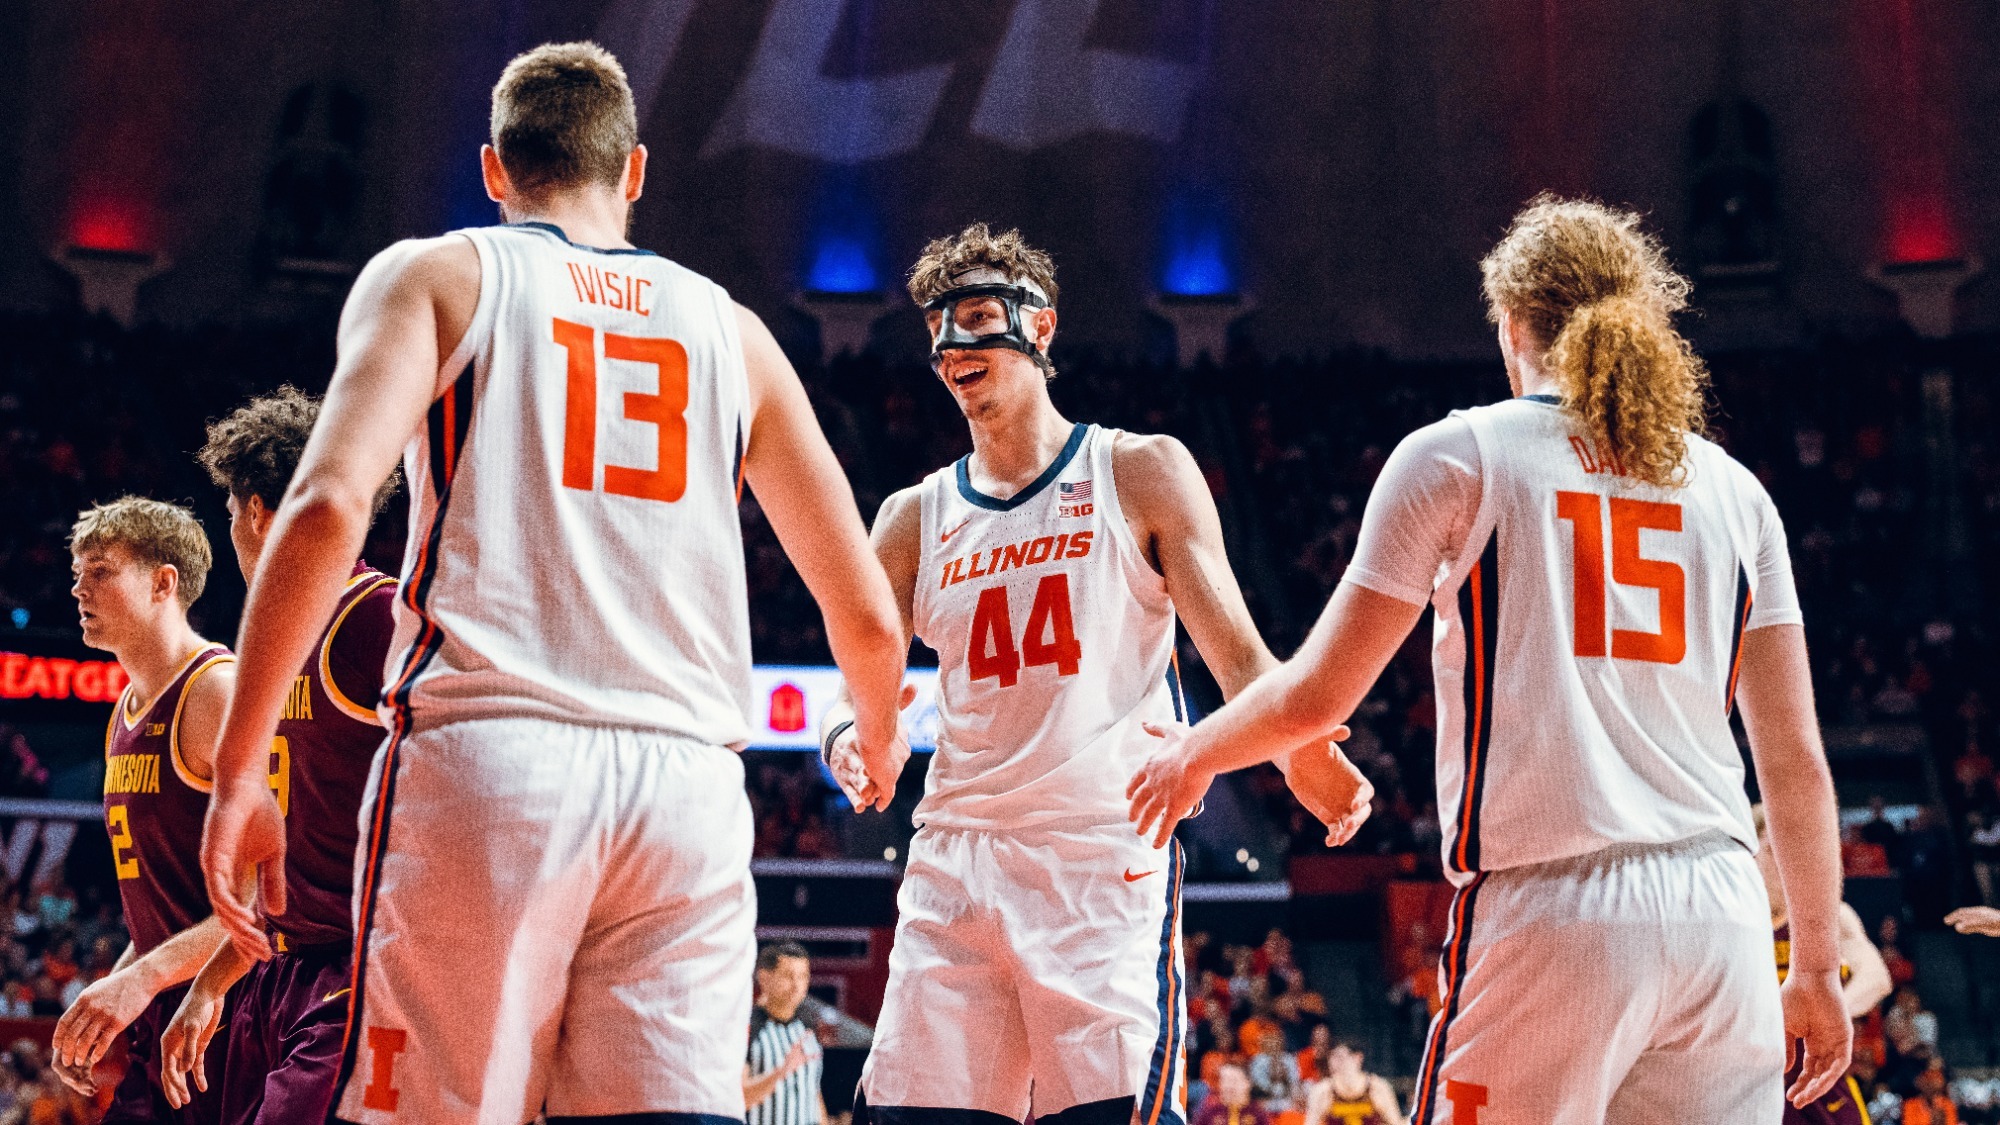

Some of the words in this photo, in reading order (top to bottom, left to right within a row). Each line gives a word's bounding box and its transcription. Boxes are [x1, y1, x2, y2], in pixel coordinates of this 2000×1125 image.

[567, 262, 652, 316] IVISIC
[552, 317, 689, 503] 13
[940, 531, 1094, 590] ILLINOIS
[1556, 490, 1686, 665] 15
[968, 573, 1081, 688] 44
[109, 804, 140, 880] 2
